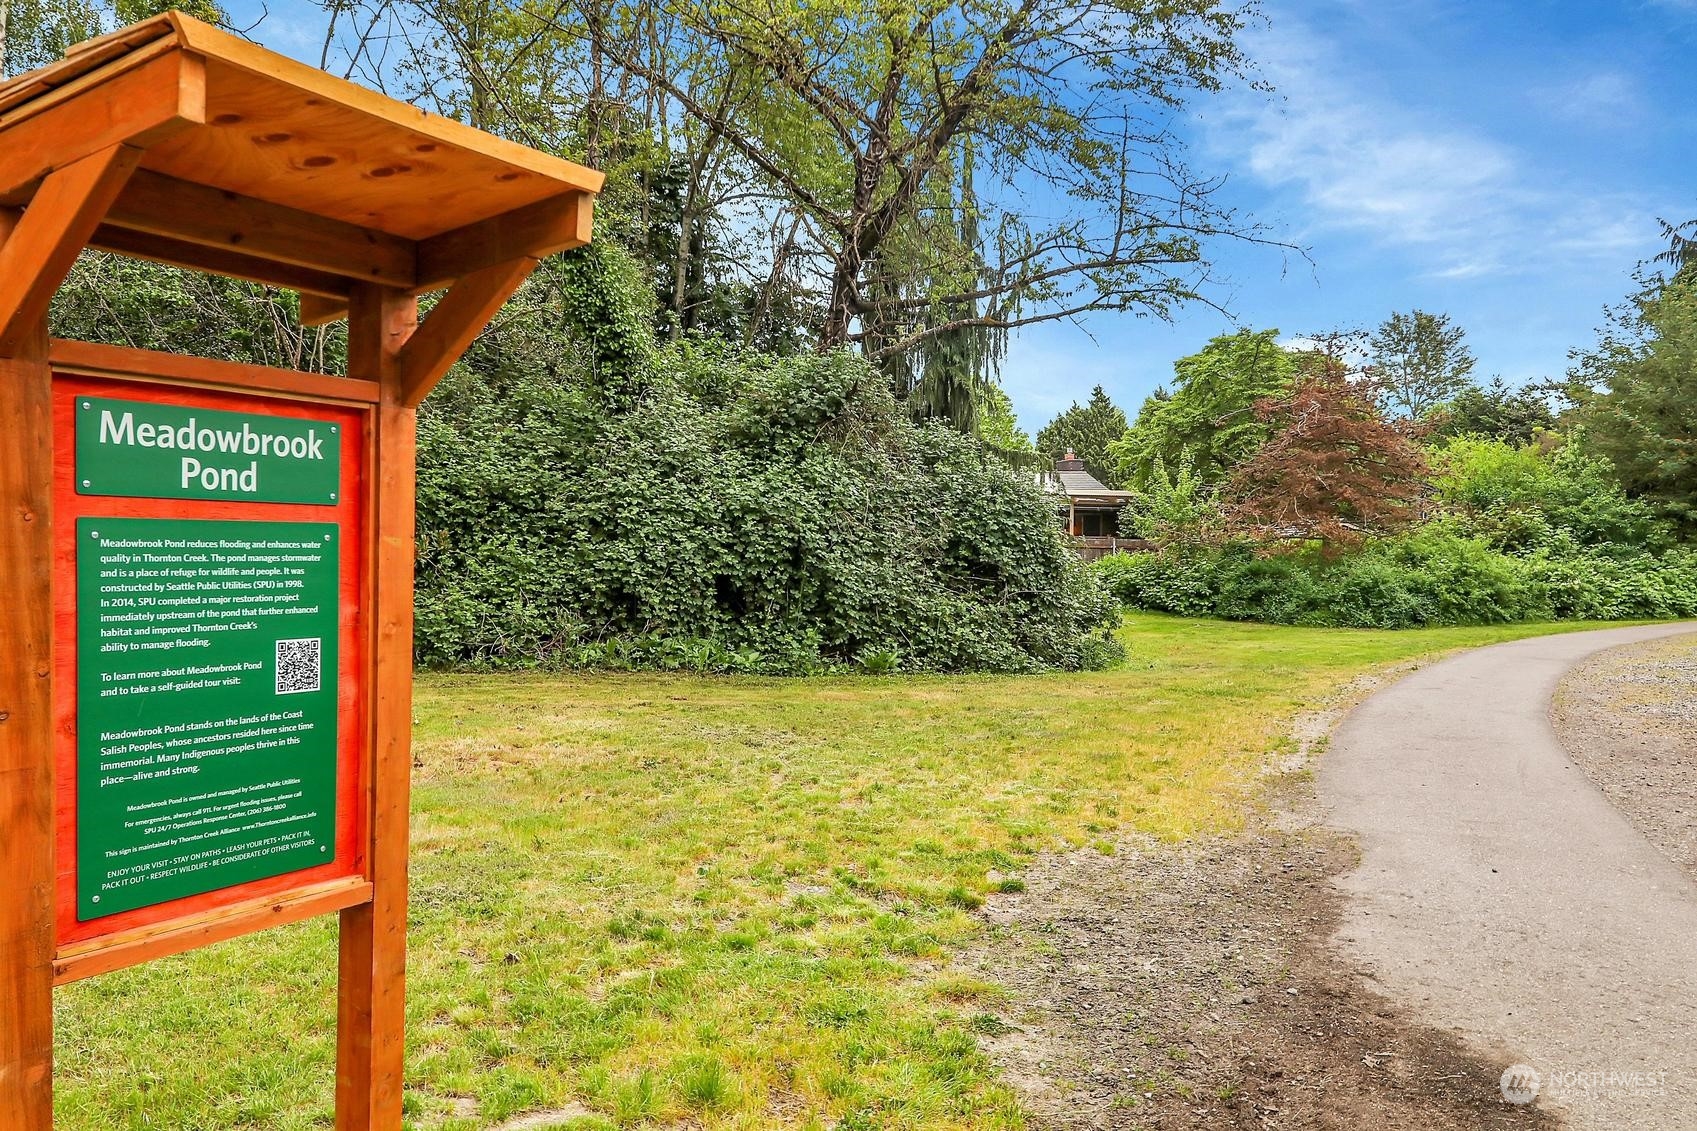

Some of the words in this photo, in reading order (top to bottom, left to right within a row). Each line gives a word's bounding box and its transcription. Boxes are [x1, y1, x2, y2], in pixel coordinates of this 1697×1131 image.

[100, 410, 323, 459] Meadowbrook
[181, 457, 257, 491] Pond
[100, 538, 163, 547] Meadowbrook
[164, 539, 185, 547] Pond
[186, 539, 218, 547] reduces
[219, 539, 250, 549] flooding
[251, 540, 265, 548] and
[266, 540, 300, 548] enhances
[100, 553, 130, 564] quality
[132, 553, 141, 561] in
[142, 553, 181, 562] Thornton
[183, 553, 209, 561] Creek.
[210, 553, 225, 561] The
[226, 553, 246, 563] pond
[247, 555, 280, 563] manages
[100, 568, 117, 577] and
[119, 568, 126, 577] is
[135, 568, 158, 578] place
[160, 568, 169, 576] of
[170, 568, 196, 577] refuge
[198, 567, 210, 575] for
[211, 567, 239, 575] wildlife
[240, 567, 254, 575] and
[256, 567, 282, 576] people.
[100, 582, 152, 592] constructed
[154, 582, 164, 592] by
[166, 582, 195, 590] Seattle
[196, 581, 220, 589] Public
[222, 581, 252, 589] Utilities
[252, 580, 275, 589] (SPU)
[284, 579, 304, 587] 1998.
[100, 598, 109, 606] In
[111, 598, 136, 607] 2014,
[138, 597, 155, 605] SPU
[157, 596, 200, 606] completed
[208, 595, 231, 604] major
[232, 594, 273, 602] restoration
[274, 593, 299, 602] project
[100, 611, 154, 621] immediately
[156, 611, 195, 621] upstream
[196, 609, 205, 617] of
[206, 609, 219, 617] the
[220, 608, 240, 618] pond
[258, 607, 283, 615] further
[284, 605, 318, 614] enhanced
[100, 627, 132, 636] habitat
[134, 626, 150, 635] and
[151, 624, 190, 634] improved
[191, 623, 228, 631] Thornton
[100, 642, 128, 651] ability
[129, 642, 139, 650] to
[141, 641, 174, 649] manage
[175, 638, 210, 647] flooding.
[100, 673, 111, 681] To
[113, 672, 135, 680] learn
[161, 667, 185, 676] about
[186, 662, 242, 674] Meadowbrook
[243, 661, 262, 669] Pond
[100, 686, 117, 696] and
[130, 684, 149, 693] take
[157, 679, 203, 691] self-guided
[100, 726, 162, 740] Meadowbrook
[164, 723, 184, 733] Pond
[186, 720, 212, 730] stands
[225, 717, 238, 726] the
[239, 715, 259, 724] lands
[260, 713, 268, 721] of
[269, 712, 281, 720] the
[282, 710, 302, 719] Coast
[100, 744, 126, 755] Salish
[128, 741, 164, 752] Peoples,
[165, 738, 192, 747] whose
[193, 733, 231, 743] ancestors
[232, 727, 259, 738] resided
[261, 727, 277, 735] here
[278, 724, 296, 732] since
[297, 722, 313, 730] time
[100, 755, 154, 770] immemorial.
[156, 754, 180, 762] Many
[181, 748, 224, 759] Indigenous
[225, 742, 255, 754] peoples
[256, 740, 277, 748] thrive
[286, 736, 300, 744] this
[154, 767, 170, 777] and
[171, 765, 200, 774] strong.
[127, 800, 167, 811] Meadowbrook
[188, 793, 206, 801] owned
[217, 787, 241, 796] managed
[248, 783, 266, 791] Seattle
[157, 824, 171, 832] 24/7
[172, 819, 202, 829] Operations
[203, 815, 227, 823] Response
[138, 839, 169, 850] maintained
[178, 834, 203, 842] Thornton
[203, 830, 218, 838] Creek
[102, 880, 120, 889] PACK
[129, 874, 144, 884] OUT
[150, 867, 177, 879] RESPECT
[179, 861, 207, 872] WILDLIFE
[220, 849, 261, 864] CONSIDERATE
[270, 844, 289, 853] OTHER
[290, 838, 314, 848] VISITORS
[107, 867, 129, 878] ENJOY
[131, 863, 150, 872] YOUR
[151, 859, 168, 868] VISIT
[173, 855, 189, 864] STAY
[201, 848, 221, 858] PATHS
[226, 843, 245, 853] LEASH
[246, 840, 262, 848] YOUR
[263, 836, 276, 845] PETS
[281, 833, 296, 841] PACK
